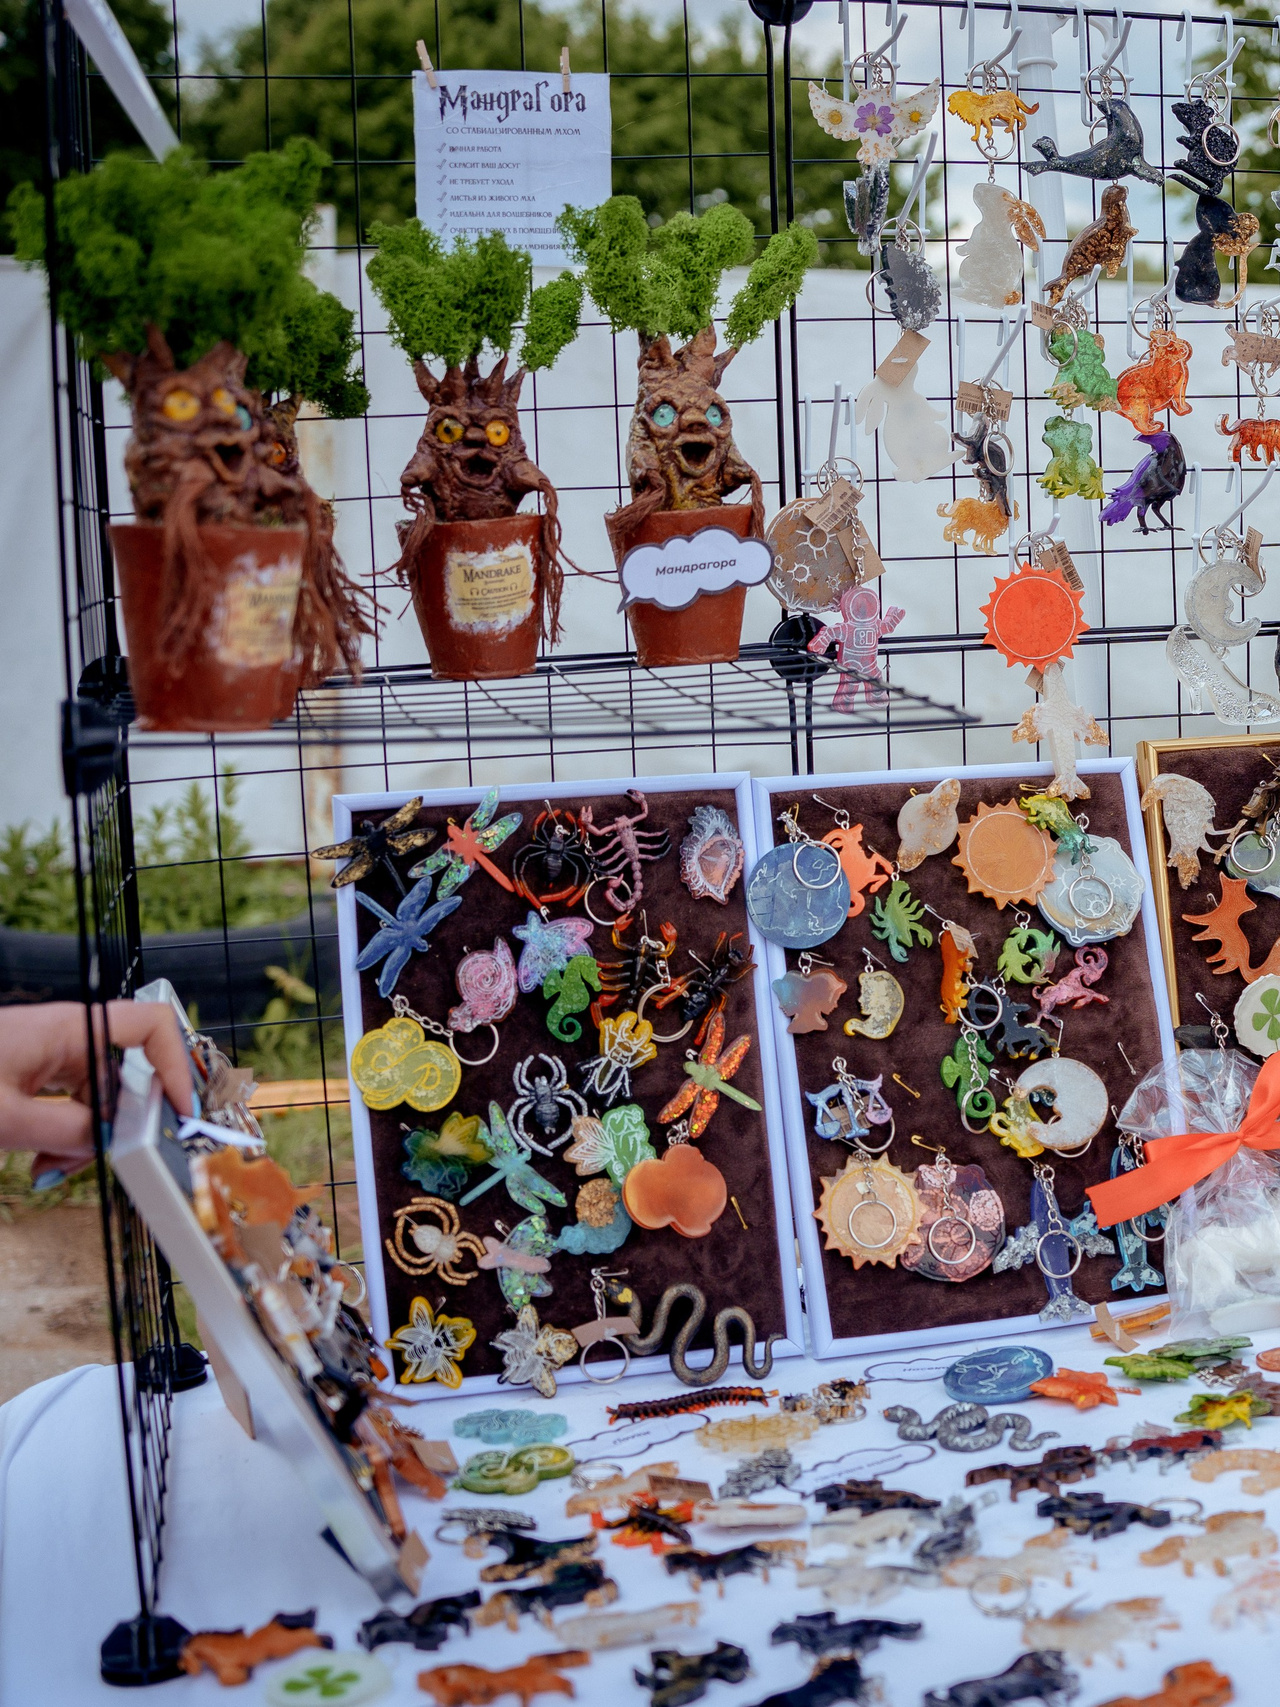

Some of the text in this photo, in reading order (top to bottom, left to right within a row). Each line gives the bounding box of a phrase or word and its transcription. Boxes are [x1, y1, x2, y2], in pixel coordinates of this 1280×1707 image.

[445, 127, 581, 136] СО СТАБИЛИЗИРОВАННЫМ МХОМ
[460, 178, 490, 186] ТРЕБУЕТ
[463, 564, 522, 583] MANDRAKE
[655, 558, 738, 577] Мандрагора
